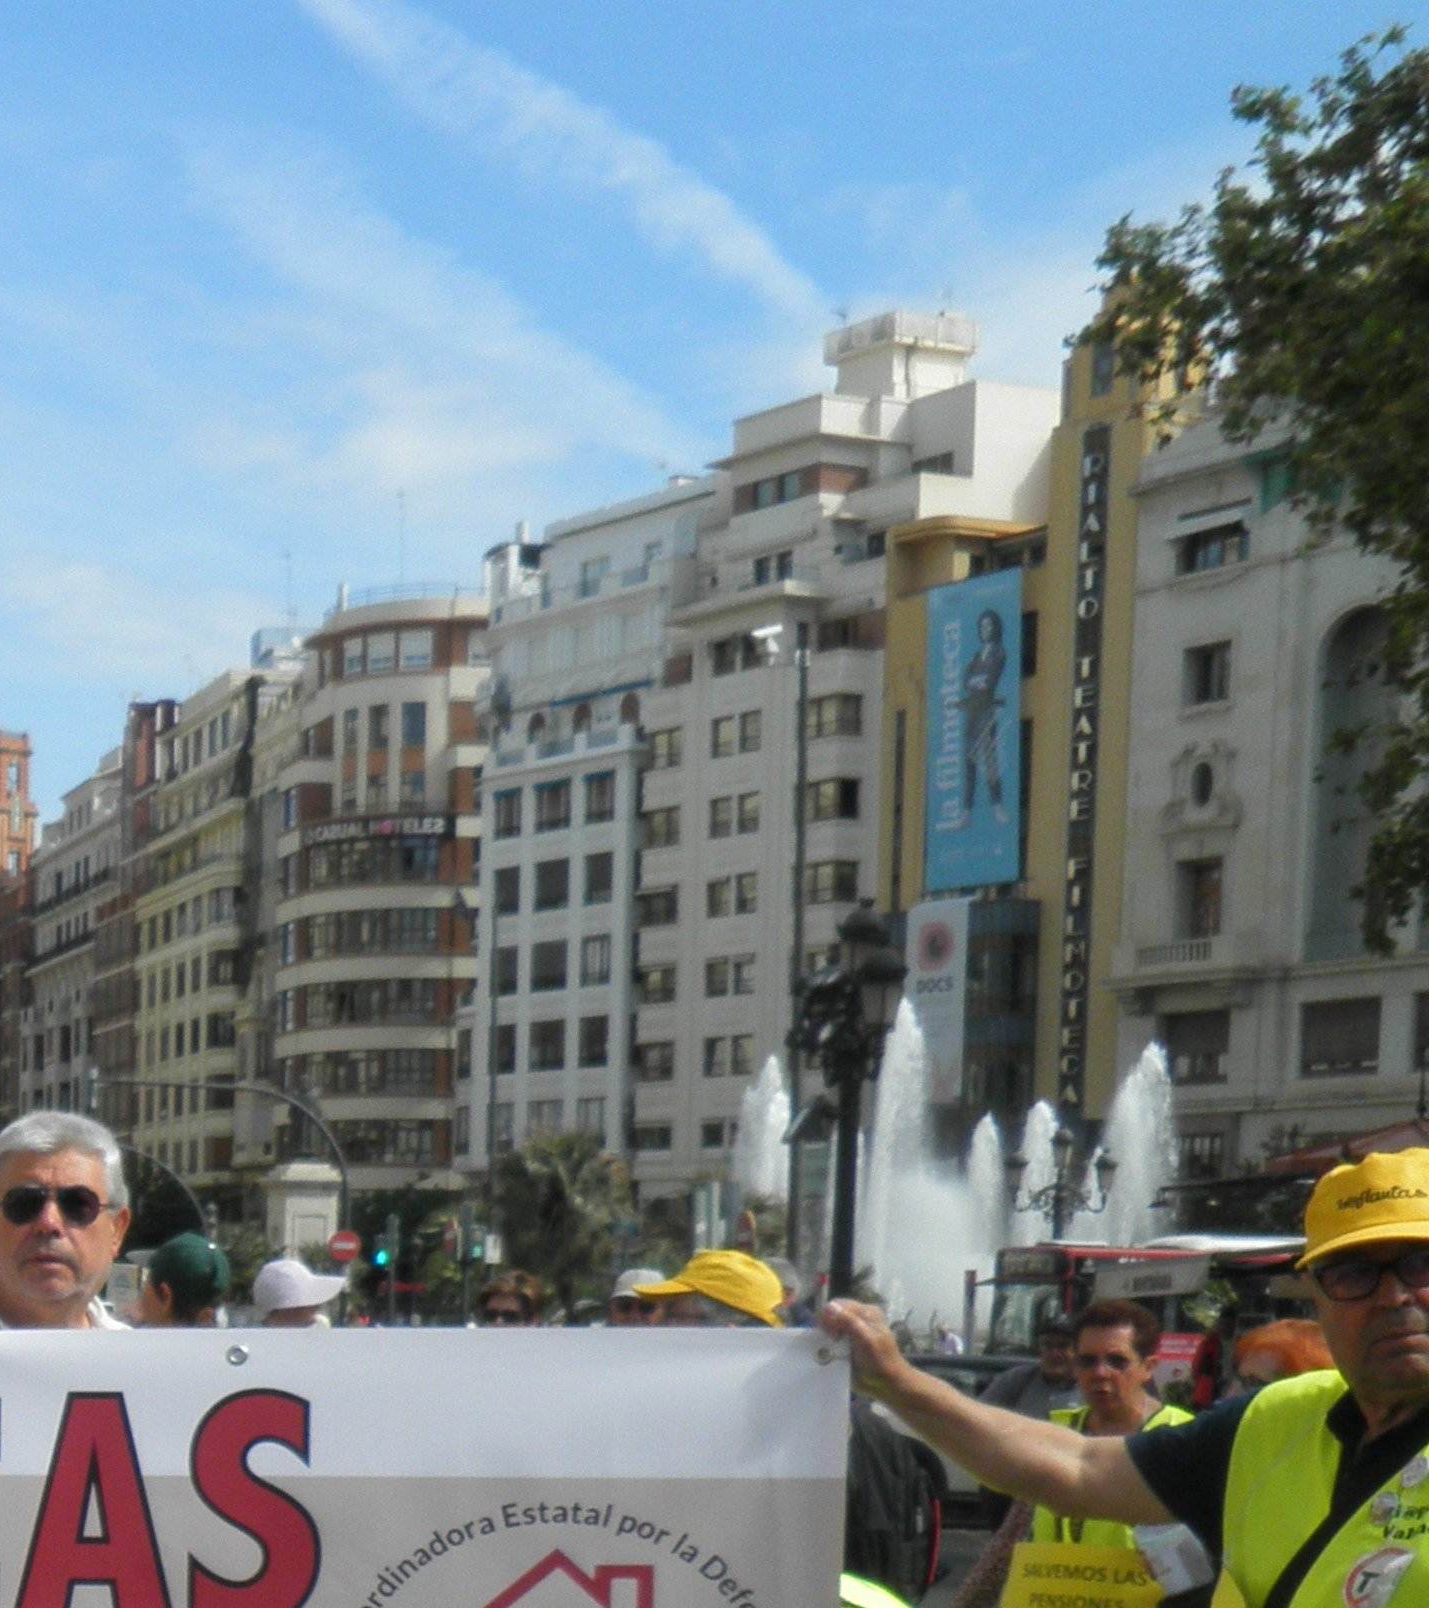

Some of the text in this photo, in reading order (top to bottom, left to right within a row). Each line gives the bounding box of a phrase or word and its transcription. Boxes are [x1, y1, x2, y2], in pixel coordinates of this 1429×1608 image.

[935, 621, 965, 831] la filmoteca
[1060, 455, 1104, 1104] RIALTO TEATRE FILMOTECA
[502, 1501, 614, 1529] Estatal
[616, 1514, 672, 1546] por
[670, 1532, 701, 1564] la
[1113, 1567, 1147, 1586] LAS
